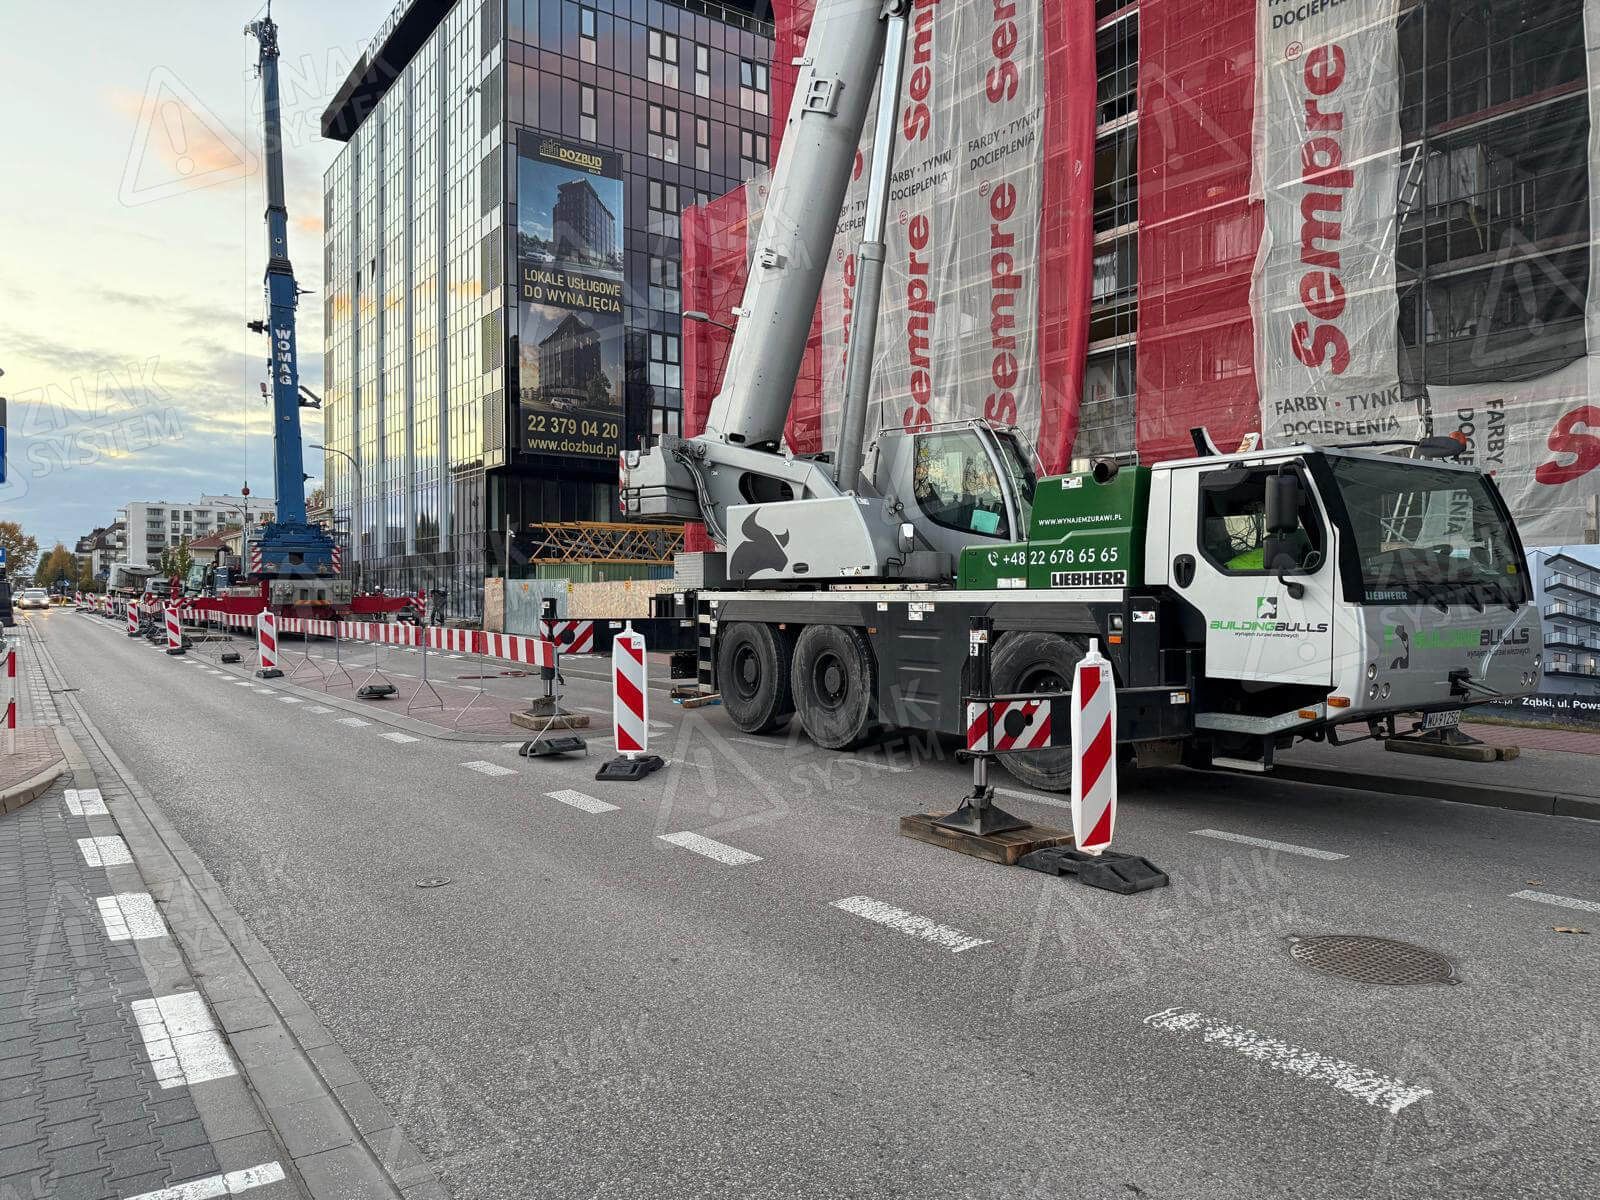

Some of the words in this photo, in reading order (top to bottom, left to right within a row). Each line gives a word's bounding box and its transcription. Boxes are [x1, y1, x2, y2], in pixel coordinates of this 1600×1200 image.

[904, 0, 940, 142] Sem
[968, 129, 1000, 152] FARBY
[970, 131, 1035, 171] DOCIEPLENIA
[560, 148, 602, 167] DOZBUD
[889, 166, 916, 183] ARBY
[922, 149, 952, 171] TYNKI
[891, 171, 948, 201] DOCIEPLENIA
[1291, 44, 1354, 375] Sempre
[524, 268, 565, 287] LOKALE
[567, 276, 621, 297] USŁUGOWE
[524, 284, 543, 299] DO
[547, 288, 621, 313] WYNAJĘCIA
[983, 182, 1022, 429] Sempre
[903, 214, 935, 435] Sempre
[275, 329, 292, 385] WOMAG
[1275, 396, 1328, 415] FARBY
[528, 415, 546, 432] 22
[551, 417, 577, 435] 379
[581, 420, 599, 437] 04
[602, 423, 619, 439] 20
[1283, 415, 1401, 437] DOCIEPLENIA
[1486, 398, 1505, 464] FARBY
[528, 438, 617, 458] www.dozbud.pl
[1003, 551, 1026, 566] +48
[1030, 550, 1046, 565] 22
[1050, 549, 1074, 564] 678
[1079, 548, 1096, 563] 65
[1100, 547, 1118, 562] 65
[1051, 572, 1125, 586] LIEBHERR
[1365, 591, 1408, 600] LIEBHERR
[1522, 697, 1555, 708] Ząbki,
[1557, 699, 1570, 708] ul.
